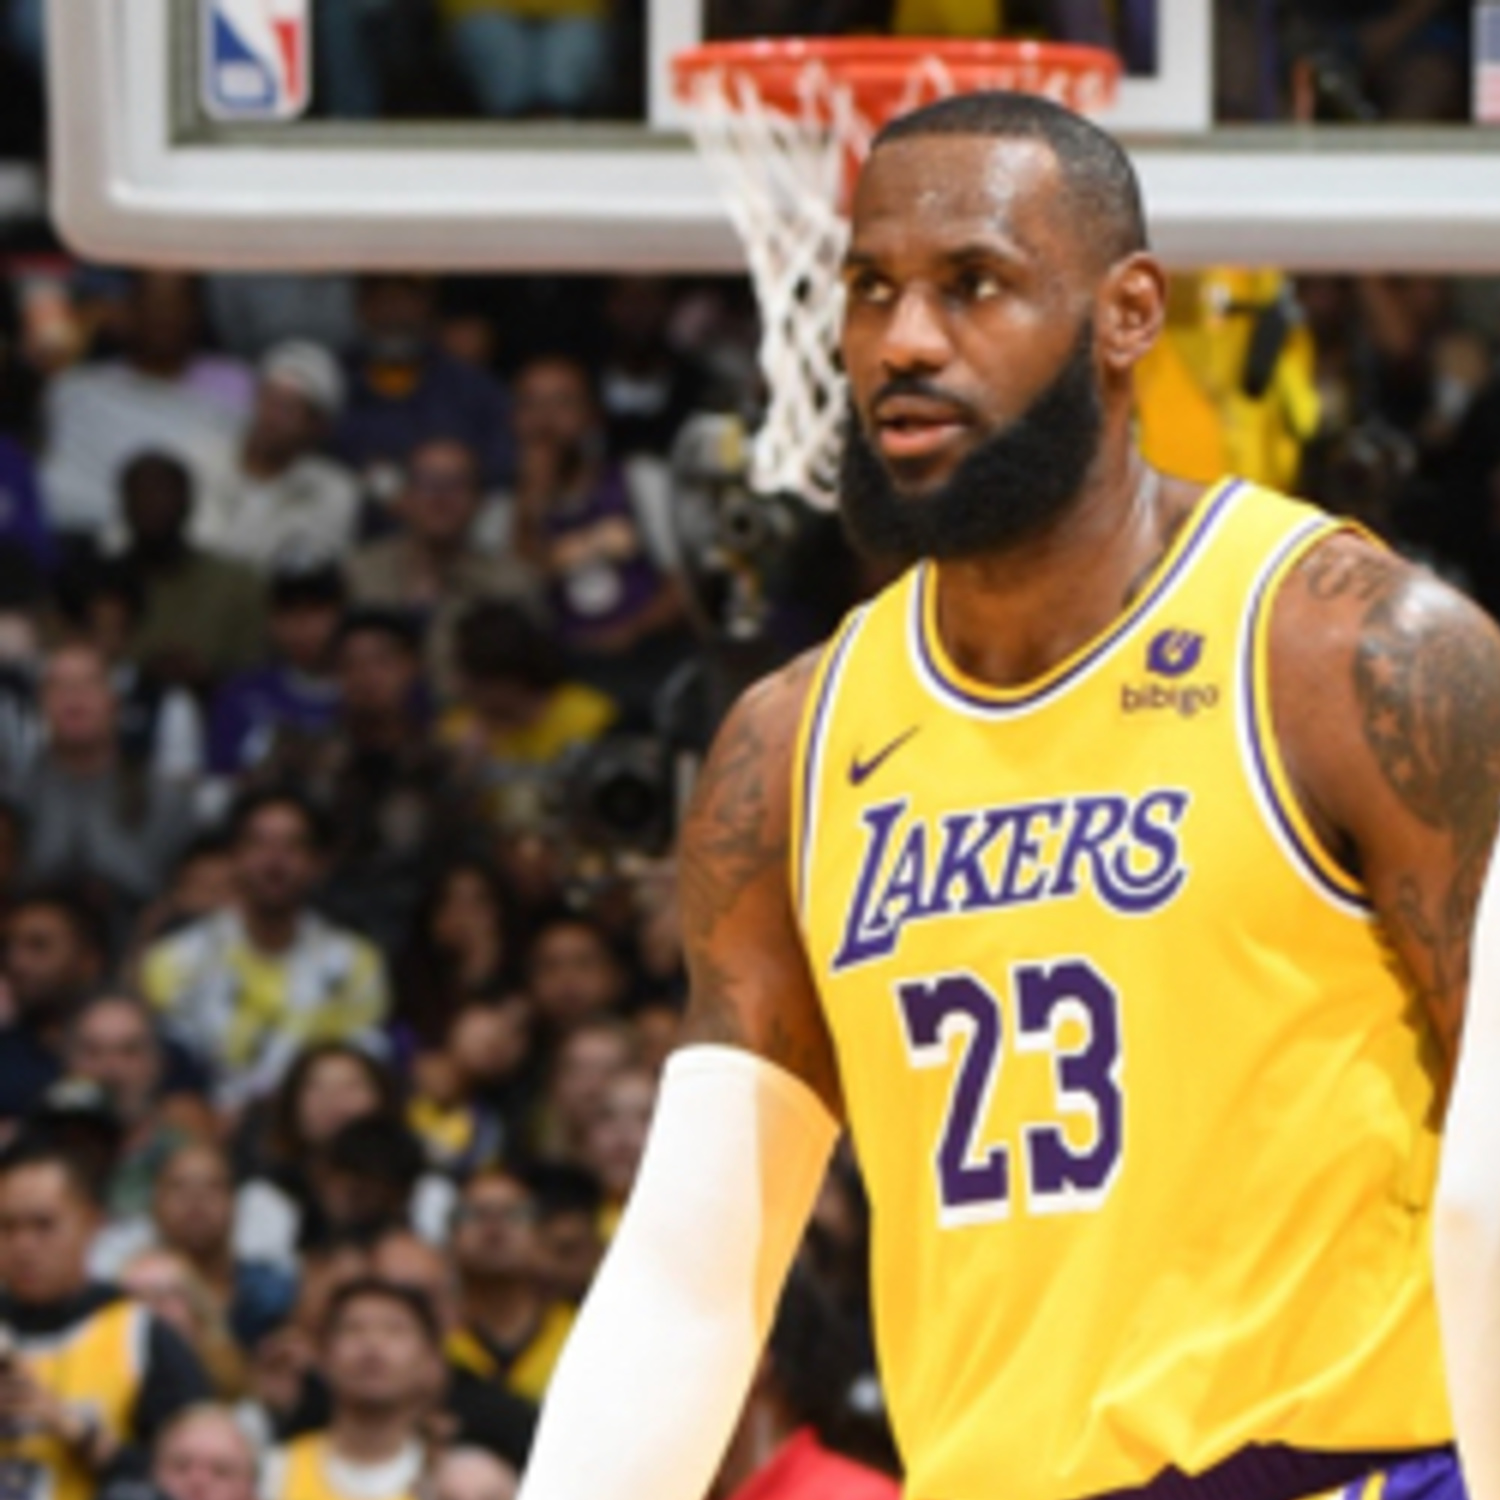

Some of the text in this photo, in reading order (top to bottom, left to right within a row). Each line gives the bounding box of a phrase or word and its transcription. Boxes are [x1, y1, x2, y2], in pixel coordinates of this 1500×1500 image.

[1120, 682, 1219, 719] bibigo
[832, 788, 1190, 972] LAKERS
[897, 957, 1123, 1226] 23
